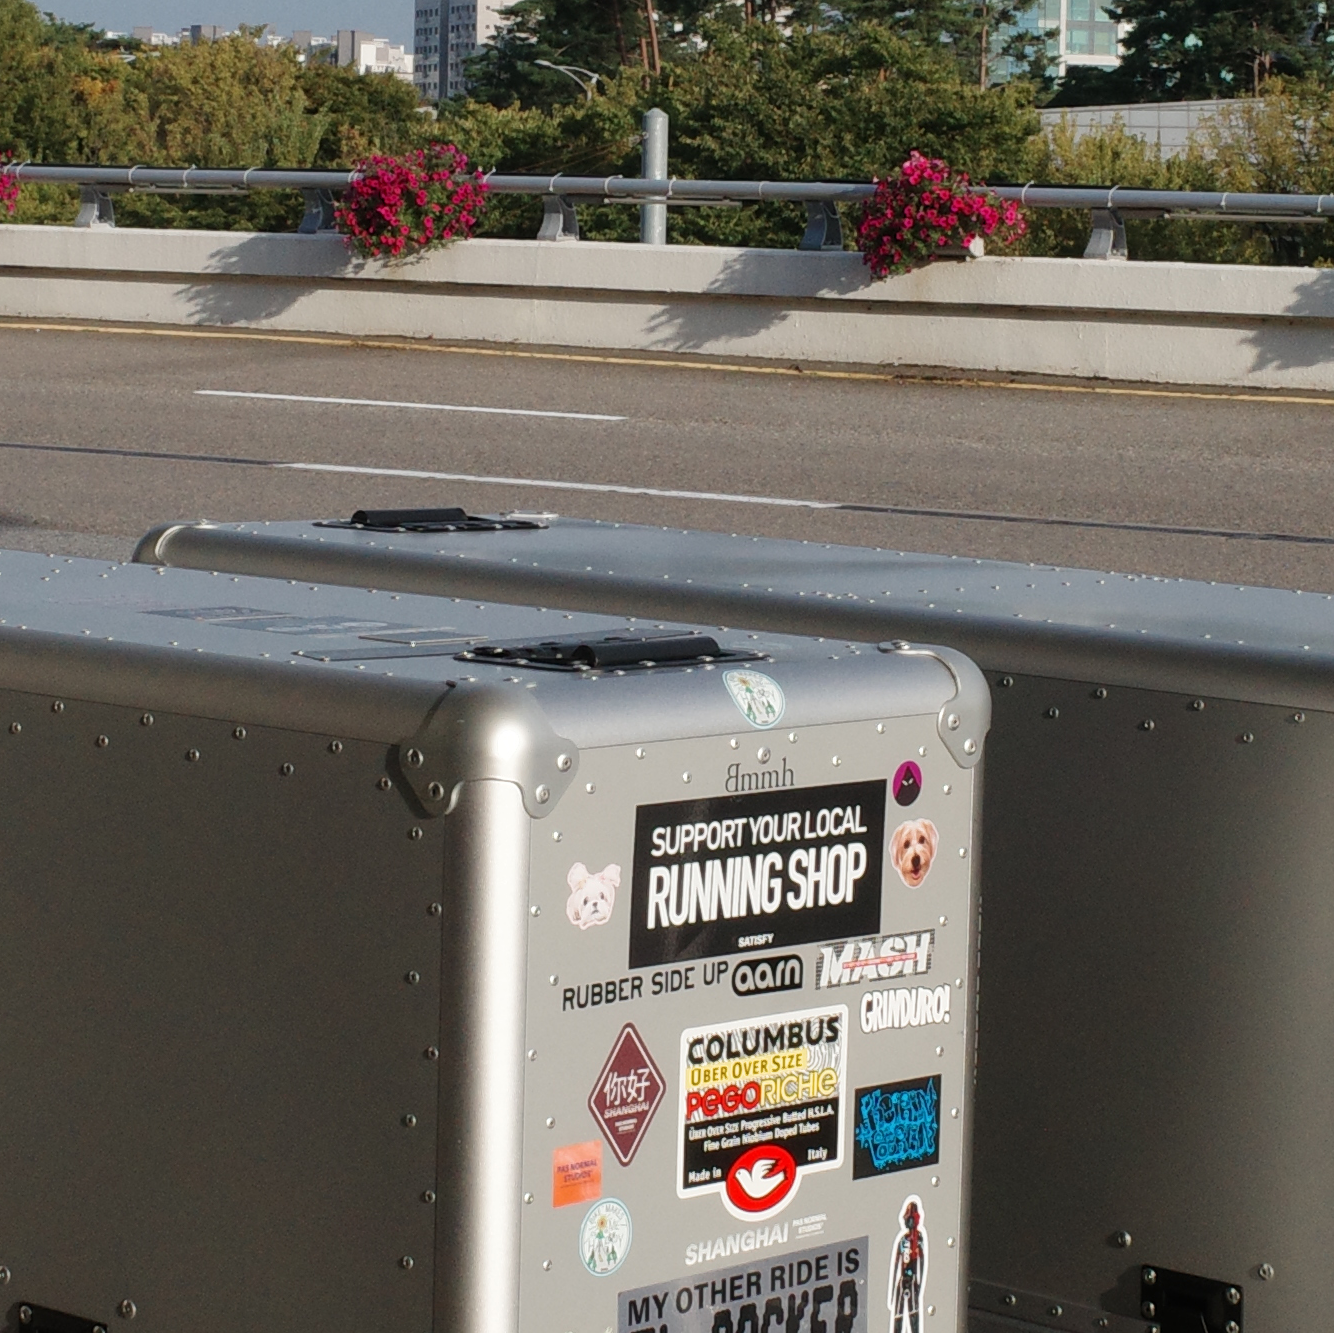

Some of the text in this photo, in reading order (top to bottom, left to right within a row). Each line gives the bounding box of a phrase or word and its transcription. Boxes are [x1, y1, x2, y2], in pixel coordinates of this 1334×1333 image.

[650, 805, 867, 857] SUPPORT YOUR LOCAL
[647, 842, 867, 930] RUNNING SHOP
[738, 933, 774, 948] SATISFY
[819, 932, 931, 988] MASH
[562, 960, 729, 1011] RUBBER SIDE UP
[860, 983, 951, 1034] GRINDURO!
[687, 1016, 840, 1064] COLUMBUS
[603, 1068, 651, 1107] 你好
[732, 1059, 769, 1079] OVER
[772, 1052, 803, 1072] SIZE
[603, 1101, 650, 1119] SHANGHAI
[741, 1114, 782, 1132] Progressive
[688, 1147, 828, 1184] Made in Italy
[685, 1222, 789, 1266] SHANGHAI
[628, 1292, 669, 1326] MY
[675, 1270, 762, 1314] OTHER
[770, 1254, 829, 1292] RIDE
[837, 1248, 860, 1276] IS
